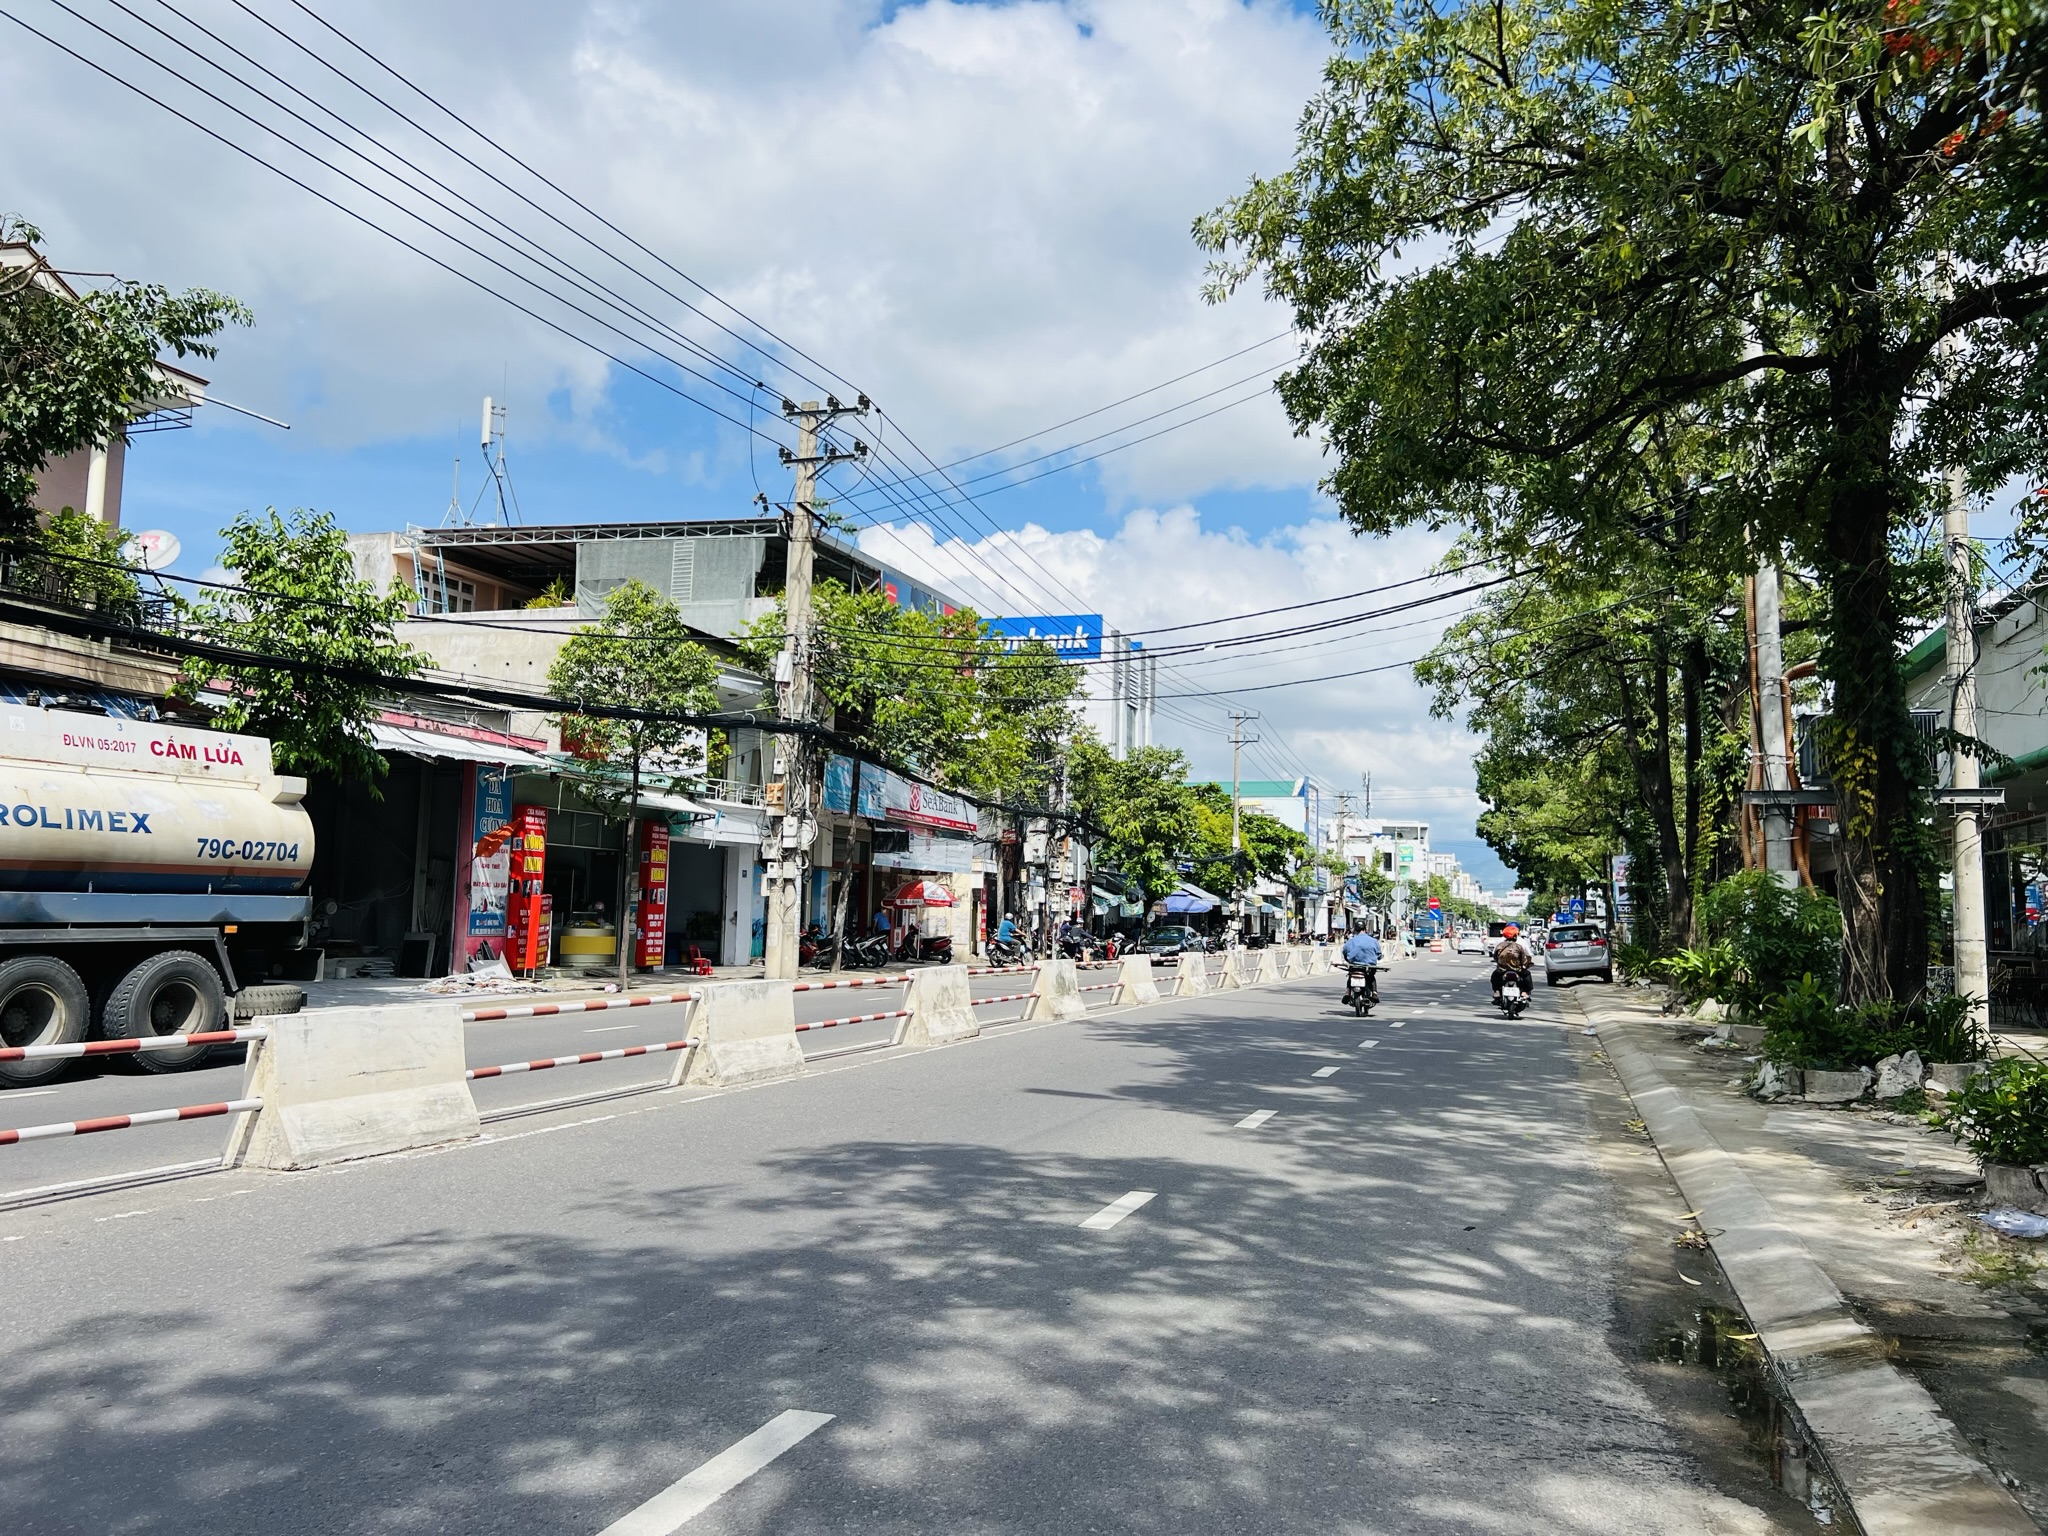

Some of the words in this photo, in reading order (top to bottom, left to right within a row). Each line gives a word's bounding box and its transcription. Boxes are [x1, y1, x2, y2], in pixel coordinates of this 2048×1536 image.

[117, 722, 123, 732] 3
[63, 733, 95, 749] ĐLVN
[97, 738, 137, 754] 05:2017
[150, 735, 198, 761] CẤM
[203, 742, 244, 766] LỬA
[226, 738, 233, 746] 4
[485, 797, 504, 815] HOA
[922, 790, 959, 815] SeABank
[197, 837, 299, 862] 79C-02704
